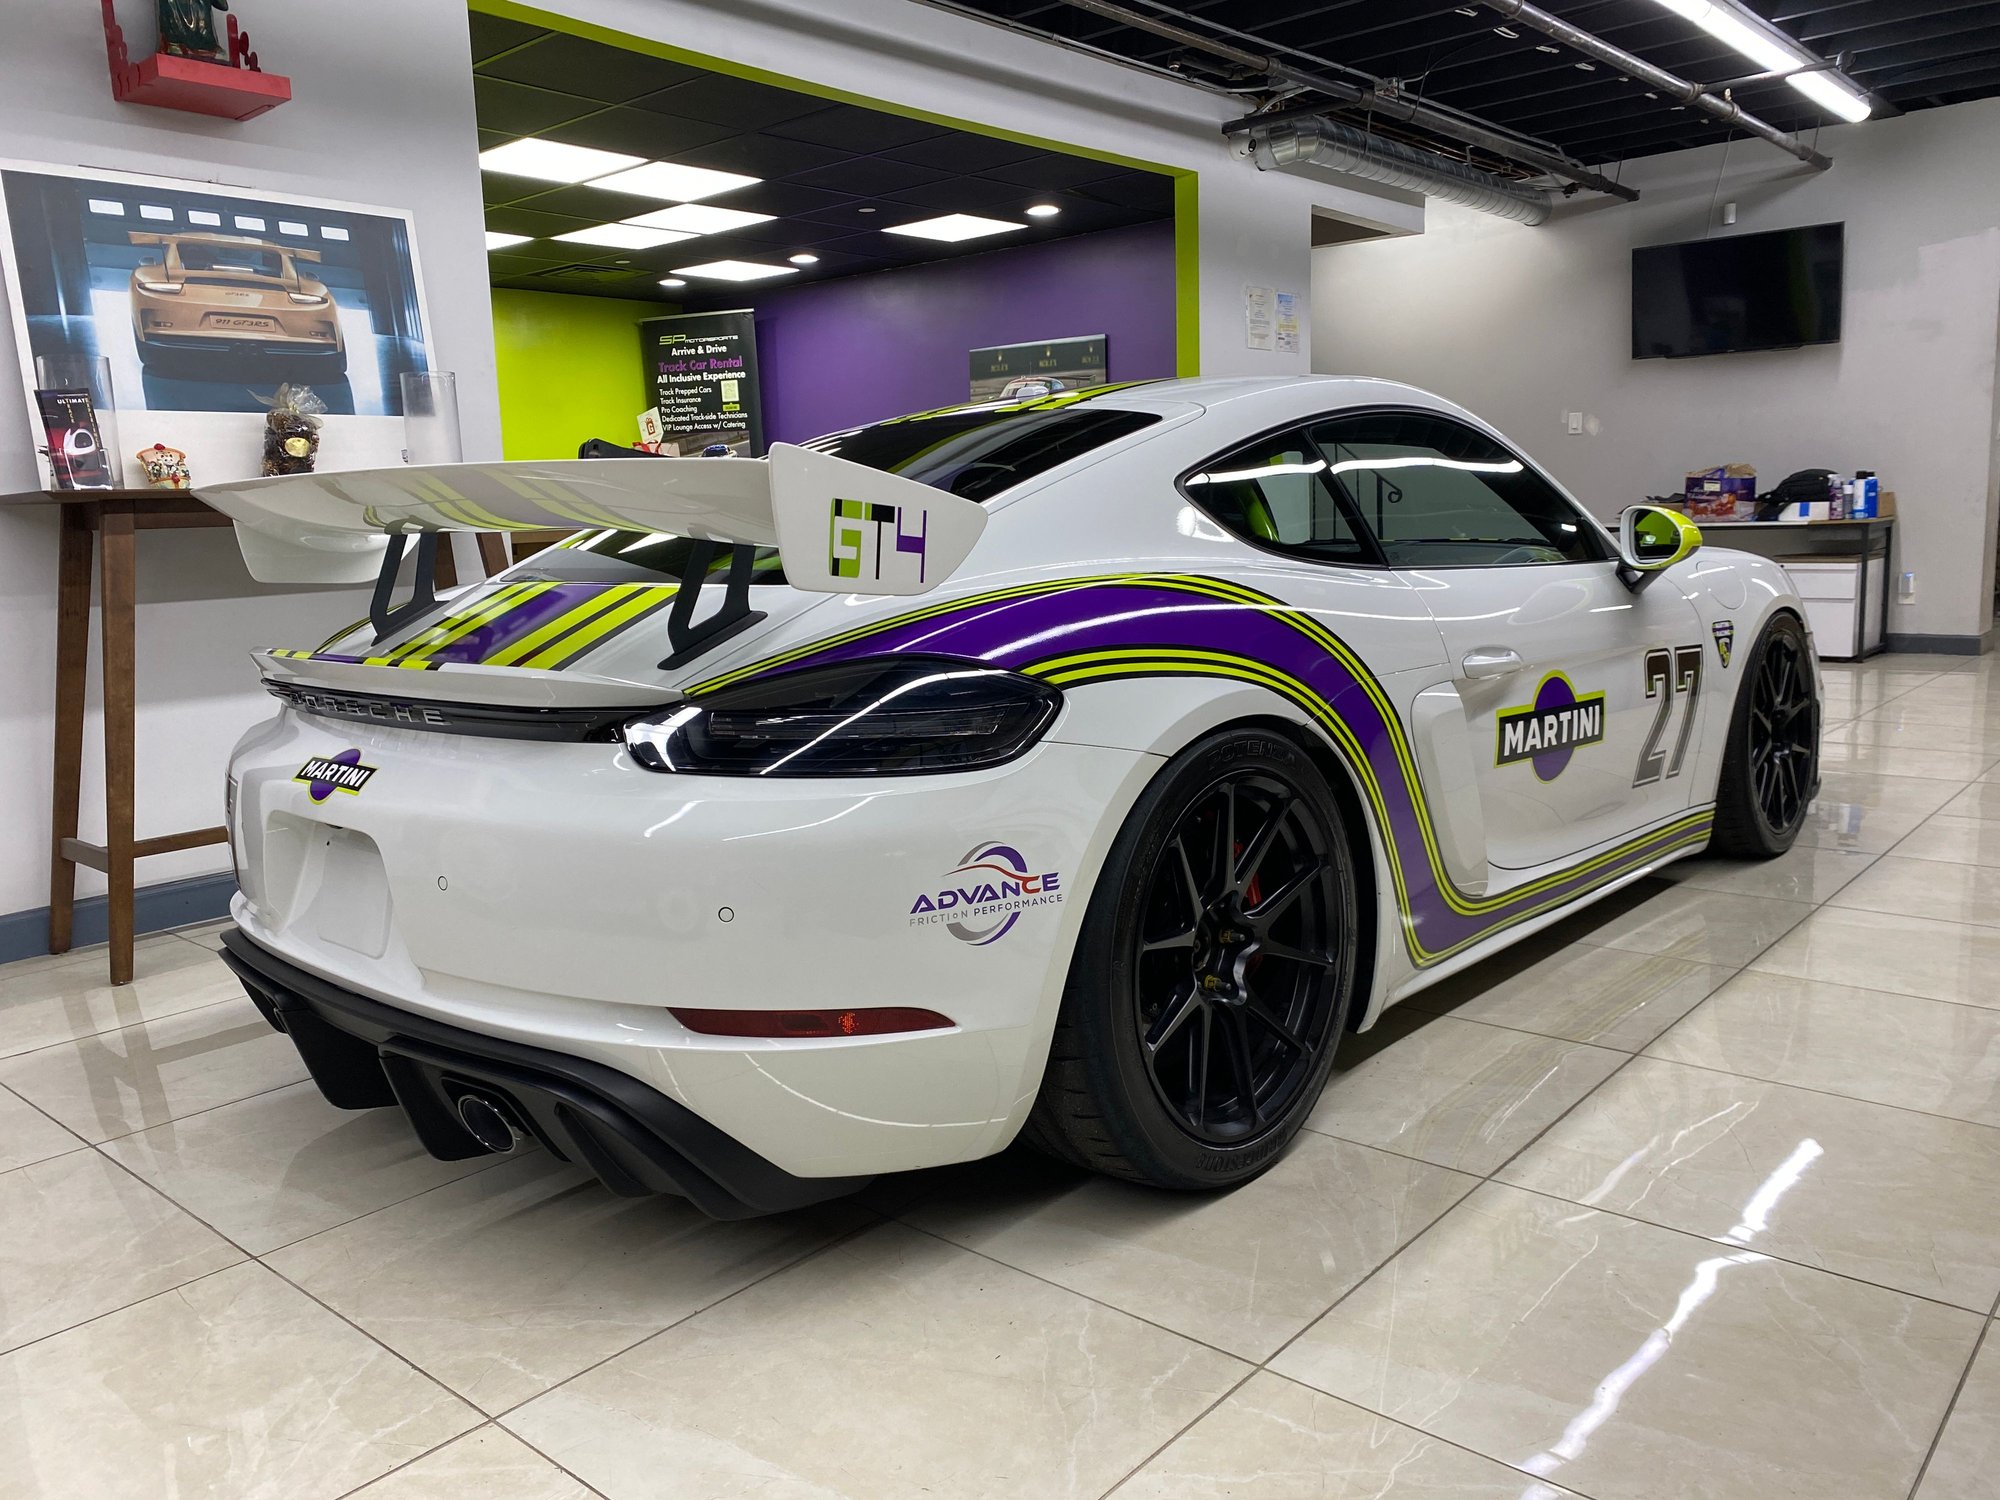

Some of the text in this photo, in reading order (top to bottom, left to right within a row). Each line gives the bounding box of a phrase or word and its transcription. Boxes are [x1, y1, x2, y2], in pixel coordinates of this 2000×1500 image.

[659, 334, 739, 345] SP MOTORSPORTS
[671, 344, 728, 356] Arrive & Drive
[658, 355, 743, 373] Track Car Rental
[657, 371, 746, 384] All Inclusive Experience
[659, 385, 712, 396] Track Prepped Cars
[675, 396, 702, 404] Insurance
[662, 414, 689, 423] Dedicated
[717, 412, 748, 420] Technicians
[671, 406, 698, 414] Coaching
[672, 423, 693, 433] Lounge
[694, 422, 712, 430] Access
[713, 421, 721, 430] w/
[722, 420, 746, 429] Catering
[829, 498, 927, 583] GT4
[289, 690, 449, 726] PORSCHE
[1632, 644, 1703, 788] 27
[1503, 704, 1601, 757] MARTINI
[1207, 740, 1297, 770] POTENZA
[300, 760, 370, 788] MARTINI
[909, 872, 1061, 914] ADVANCE
[909, 893, 1063, 927] FRICTION PERFORMANCE
